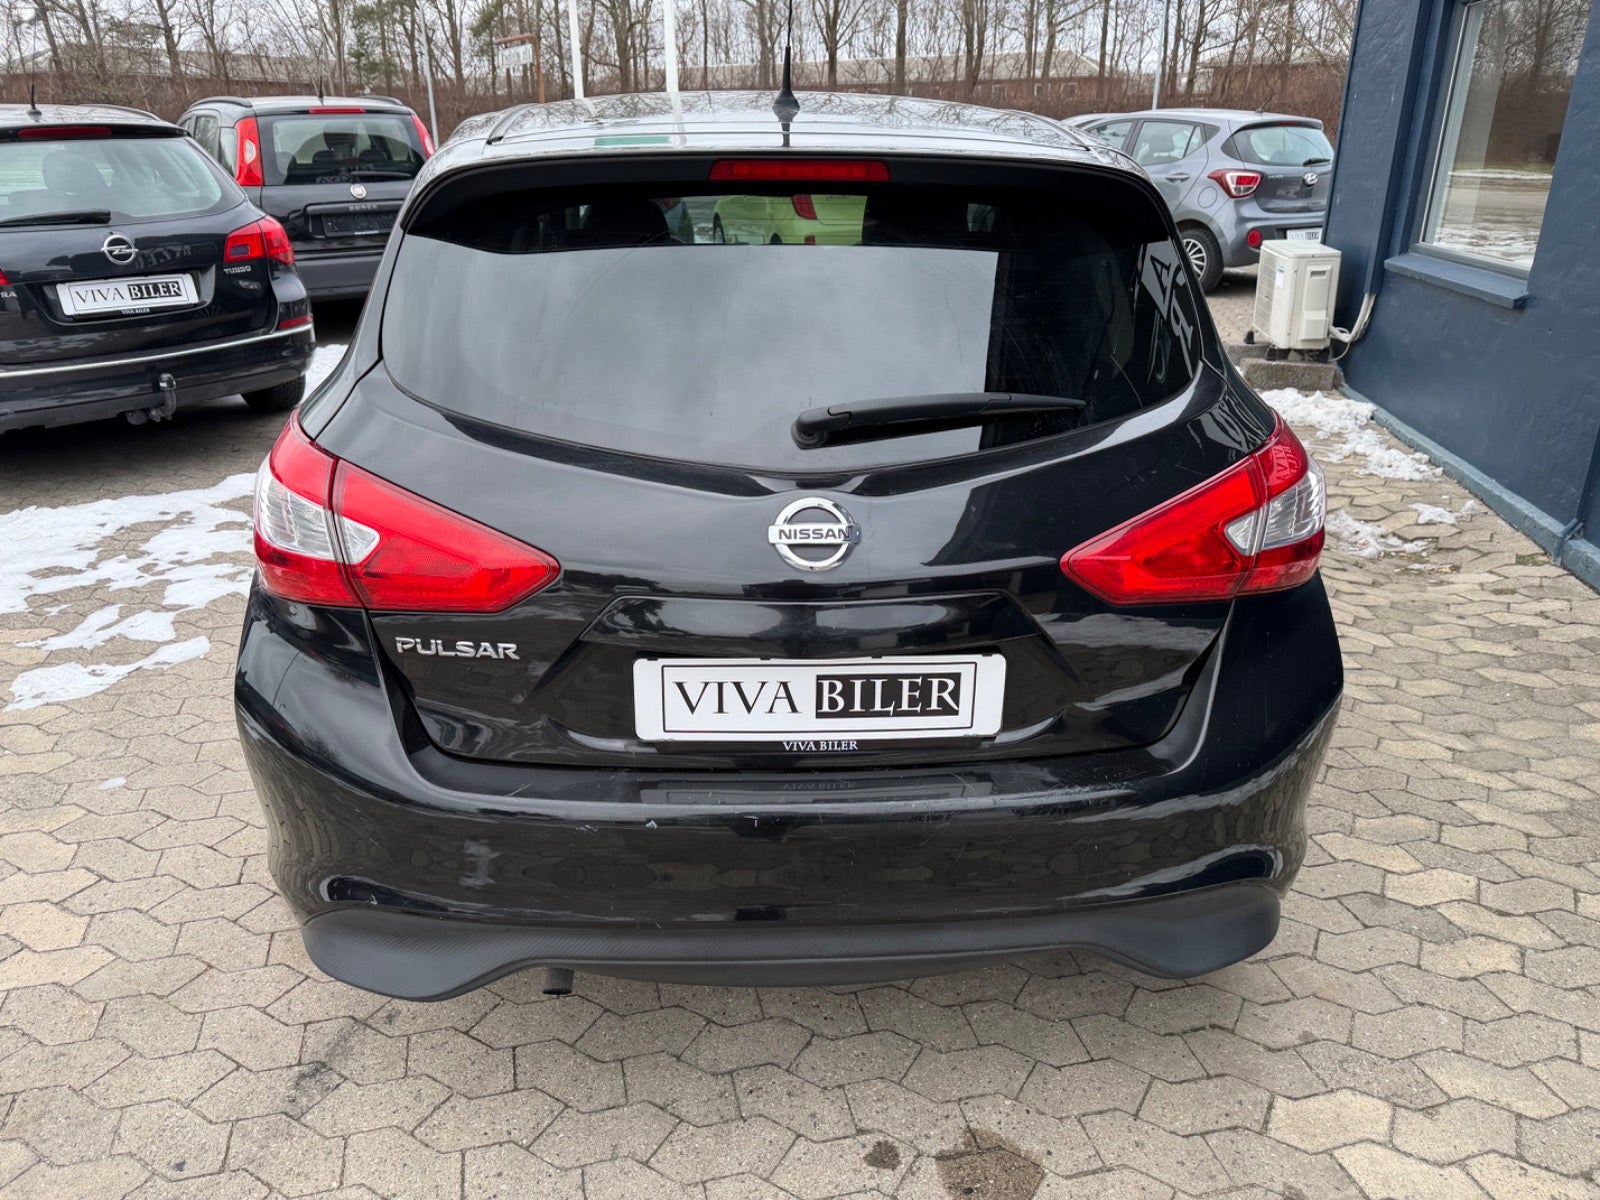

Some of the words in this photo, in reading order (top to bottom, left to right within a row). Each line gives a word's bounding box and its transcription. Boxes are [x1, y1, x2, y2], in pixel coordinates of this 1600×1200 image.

[75, 287, 125, 303] VIVA
[128, 281, 182, 299] BILER
[778, 528, 850, 540] NISSAN
[395, 636, 520, 660] PULSAR
[672, 680, 802, 715] VIVA
[816, 675, 960, 716] BILER
[783, 741, 817, 751] VIVA
[819, 740, 858, 751] BILER
